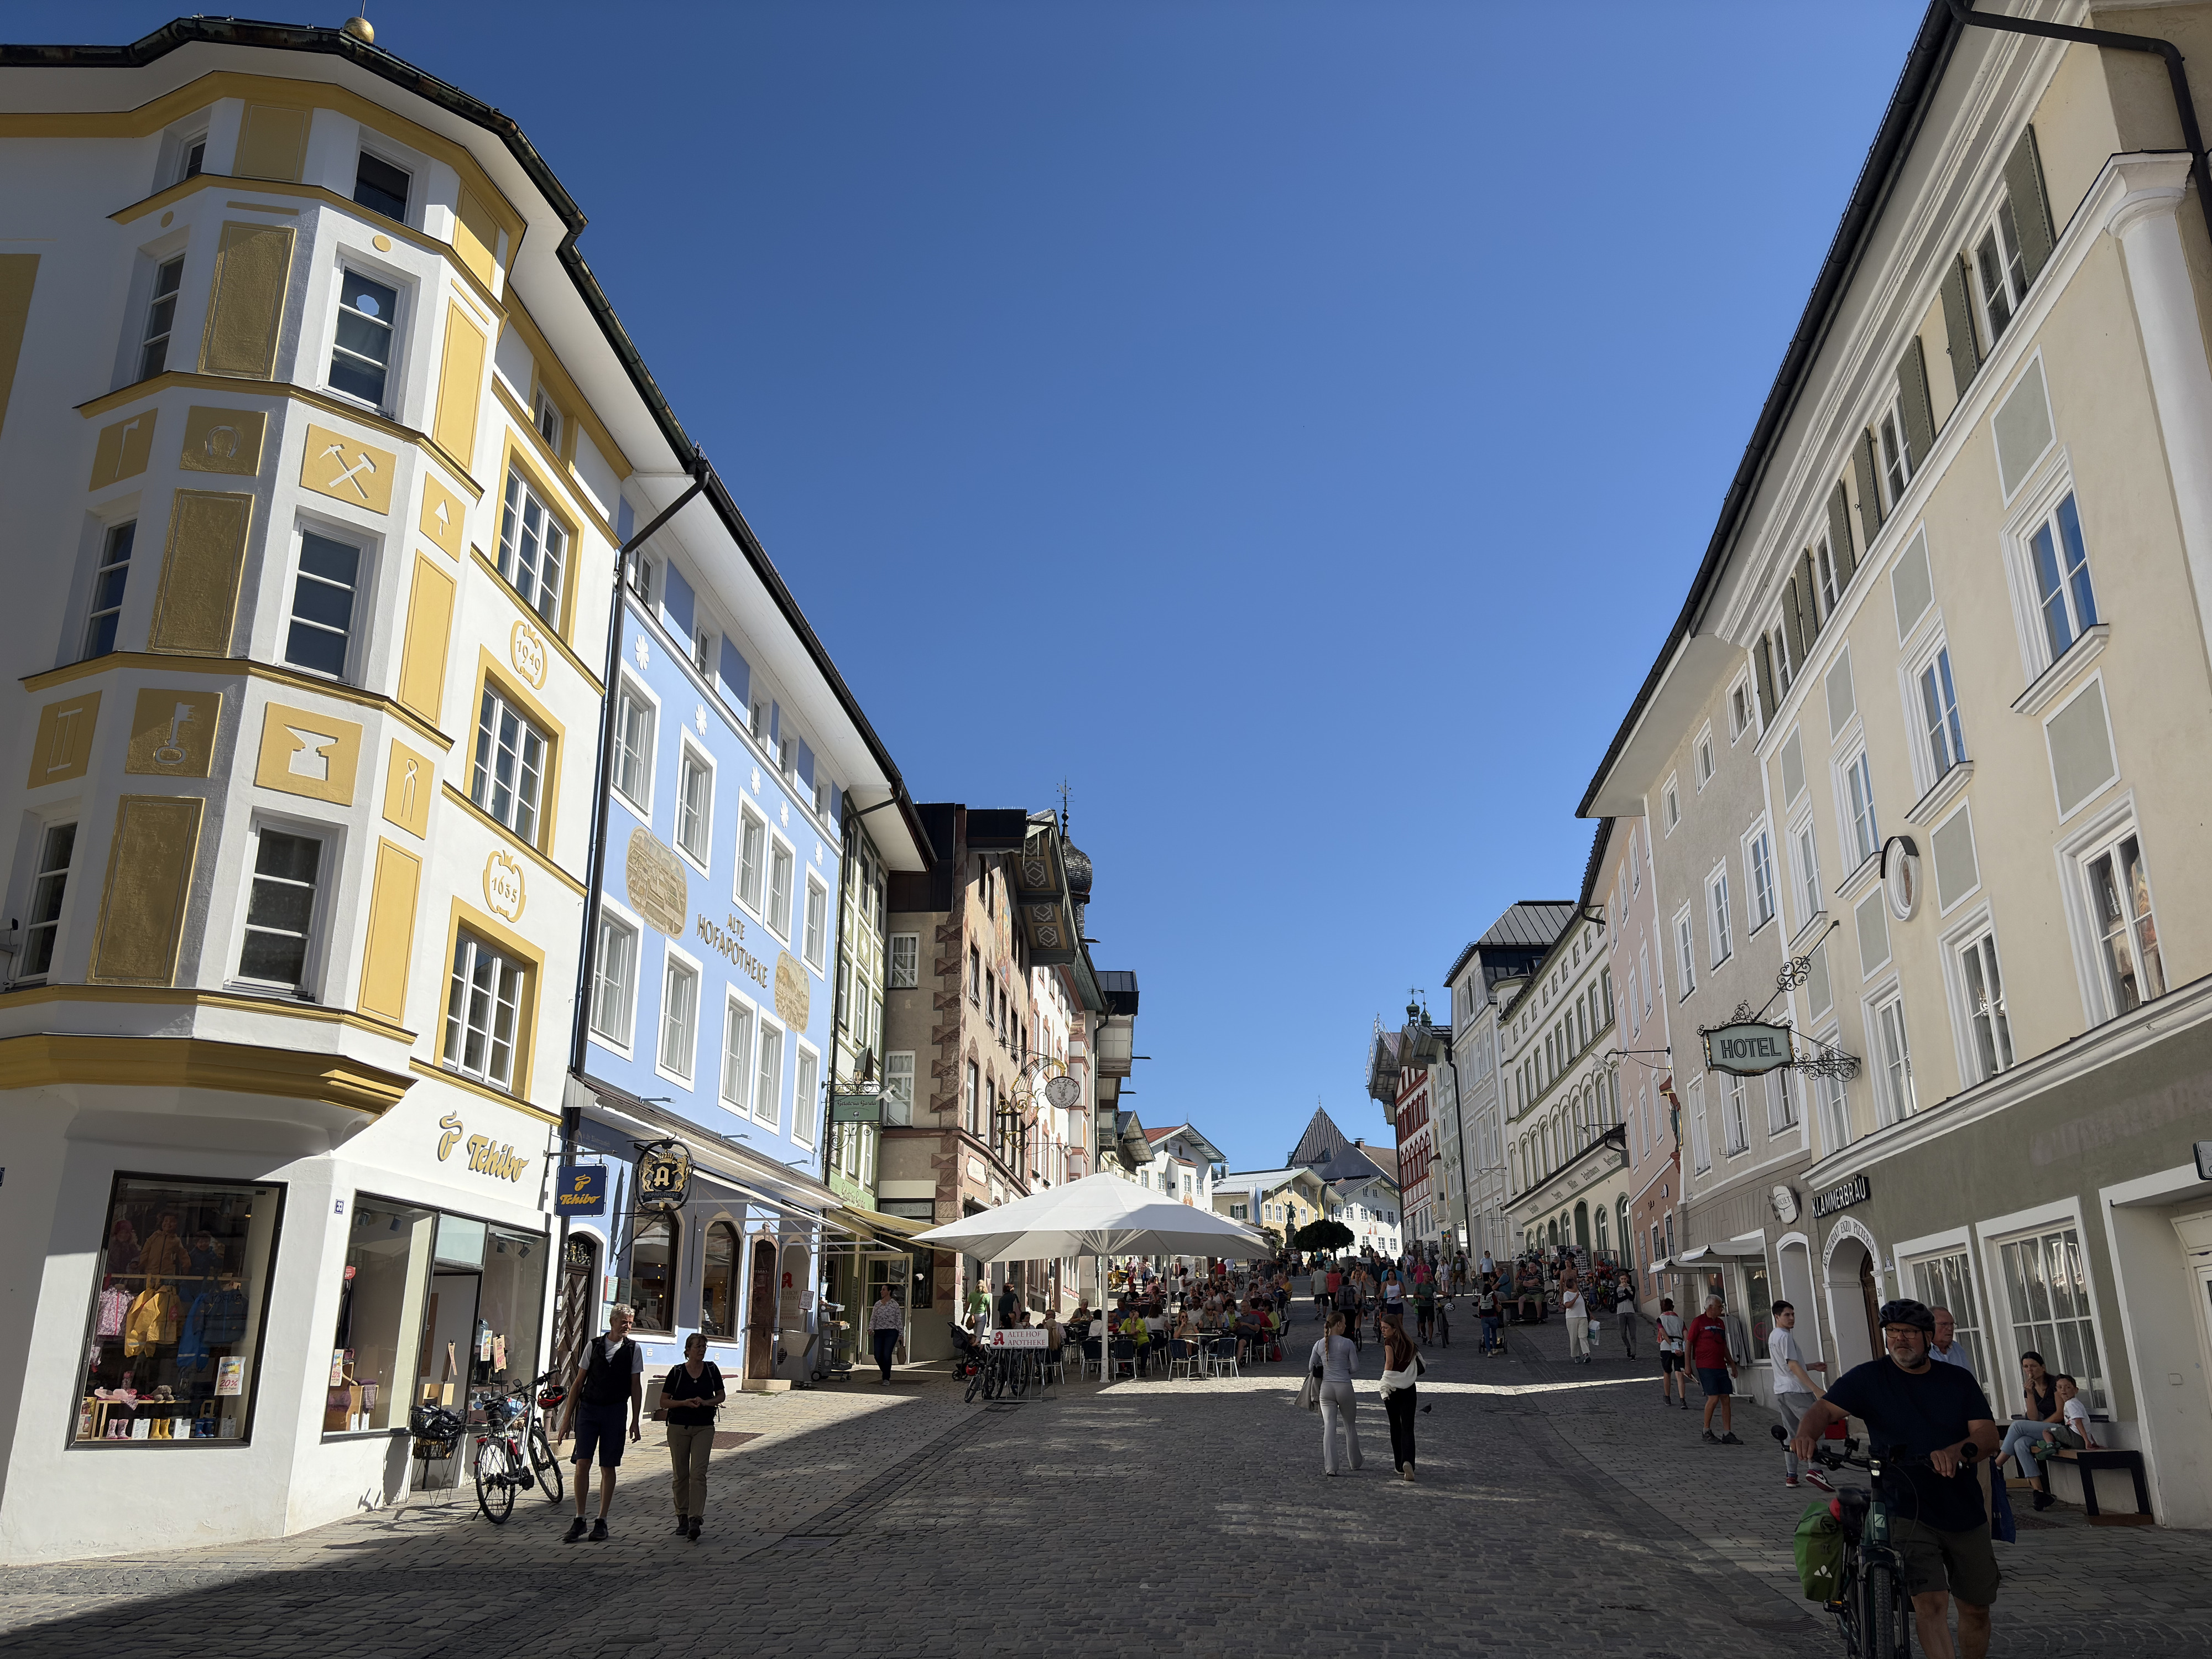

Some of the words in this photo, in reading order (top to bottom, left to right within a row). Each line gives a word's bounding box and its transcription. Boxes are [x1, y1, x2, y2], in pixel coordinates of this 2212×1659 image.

[517, 639, 541, 675] 1949
[492, 875, 518, 903] 1635
[726, 913, 745, 941] ALTE
[696, 914, 768, 989] HOFAPOTHEKE
[1720, 1037, 1782, 1059] HOTEL
[1048, 1092, 1077, 1108] TRACHTENSTUBE
[467, 1134, 530, 1183] Tchibo
[653, 1166, 670, 1187] A
[336, 1201, 343, 1212] 33
[560, 1193, 601, 1206] Tchibo
[1812, 1174, 1866, 1218] KLAMMERBRÄU
[1823, 1225, 1840, 1270] RESTAURANT
[1840, 1220, 1851, 1234] ENZO
[1853, 1221, 1875, 1259] PIZZERIA
[1877, 1287, 1882, 1297] 30
